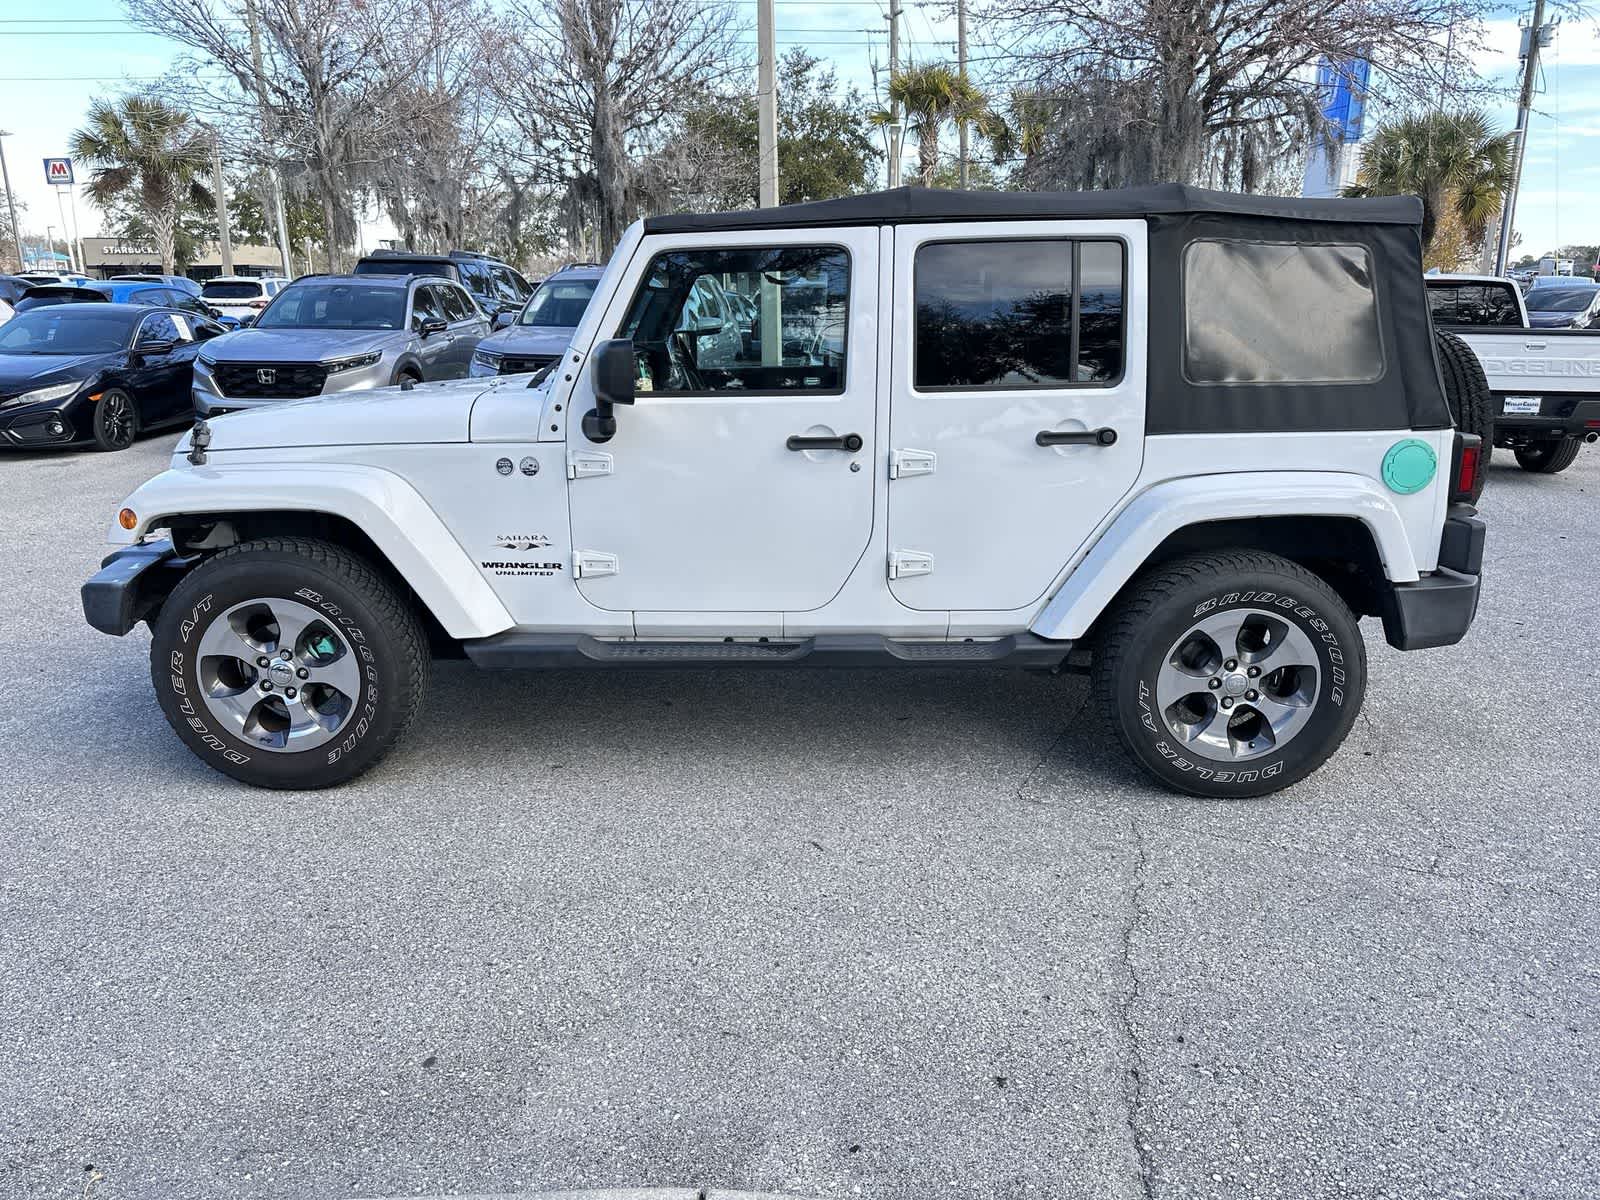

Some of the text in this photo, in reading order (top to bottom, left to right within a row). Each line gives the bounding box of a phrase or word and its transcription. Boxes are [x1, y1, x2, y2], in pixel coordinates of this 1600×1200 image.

[52, 163, 67, 175] M
[482, 562, 563, 570] WRANGLER
[171, 594, 250, 766] DUELER A/T
[294, 587, 378, 765] BRIDGESTONE
[1193, 591, 1345, 706] BRIDGESTONE
[1138, 680, 1284, 783] DUELER A/T
